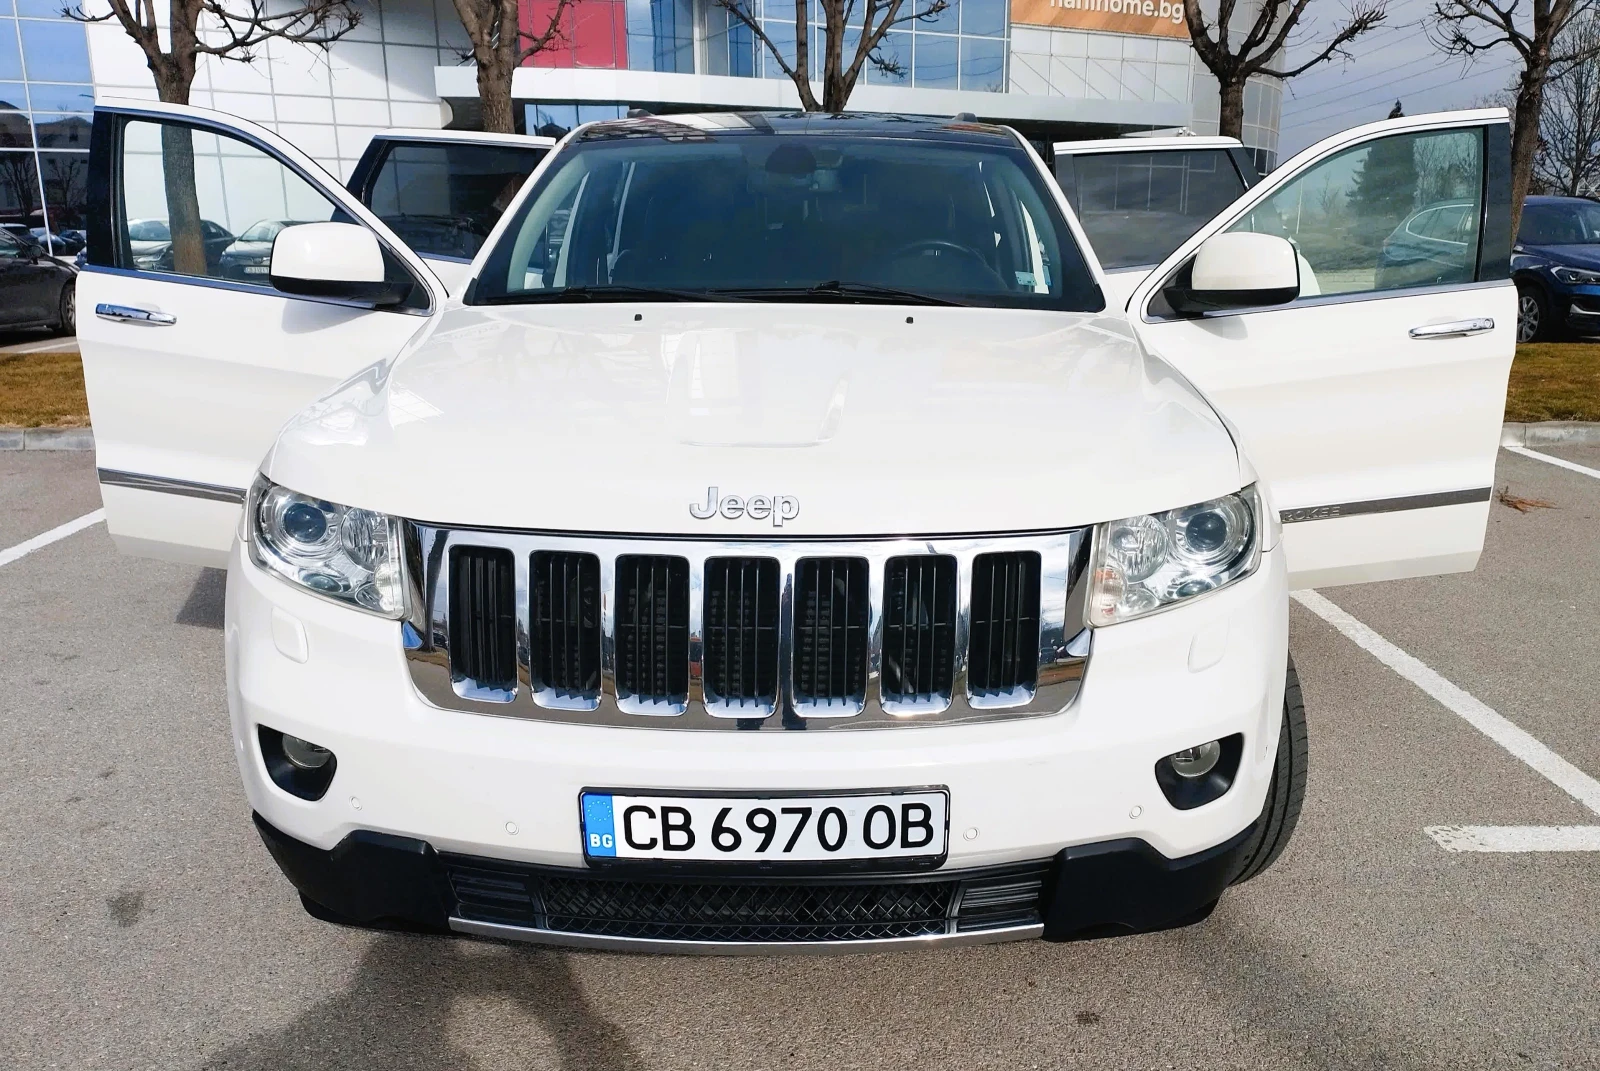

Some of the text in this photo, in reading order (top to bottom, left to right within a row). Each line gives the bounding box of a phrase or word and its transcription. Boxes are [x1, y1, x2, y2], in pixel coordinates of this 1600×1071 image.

[689, 486, 800, 527] Jeep
[589, 833, 613, 848] BG
[623, 802, 935, 853] CB 6970 OB
